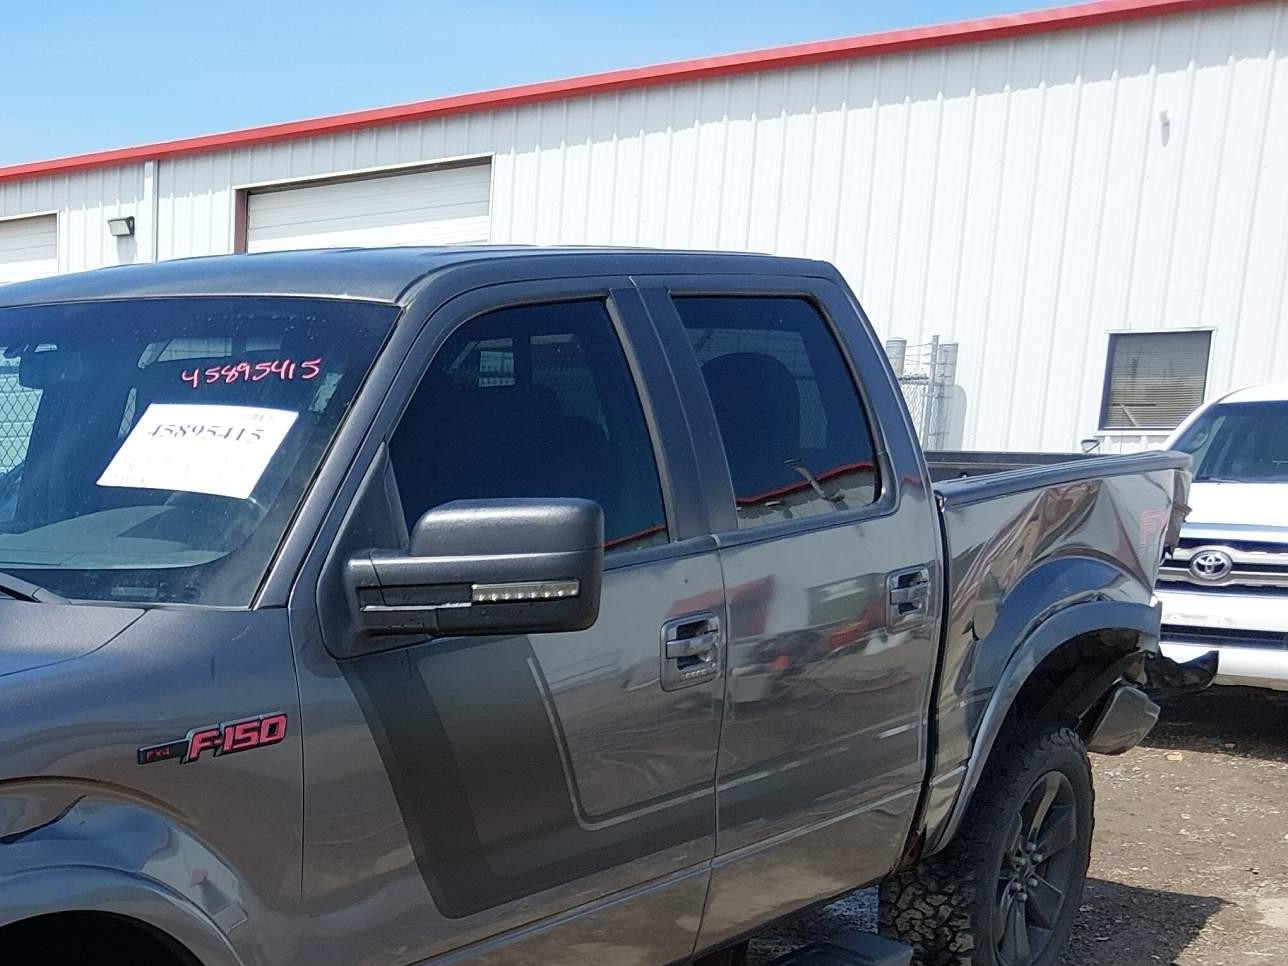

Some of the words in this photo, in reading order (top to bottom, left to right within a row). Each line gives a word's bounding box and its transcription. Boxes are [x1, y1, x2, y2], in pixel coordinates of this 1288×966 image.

[182, 357, 321, 389] 45895415
[147, 423, 266, 443] 45895415
[188, 713, 288, 761] F-150
